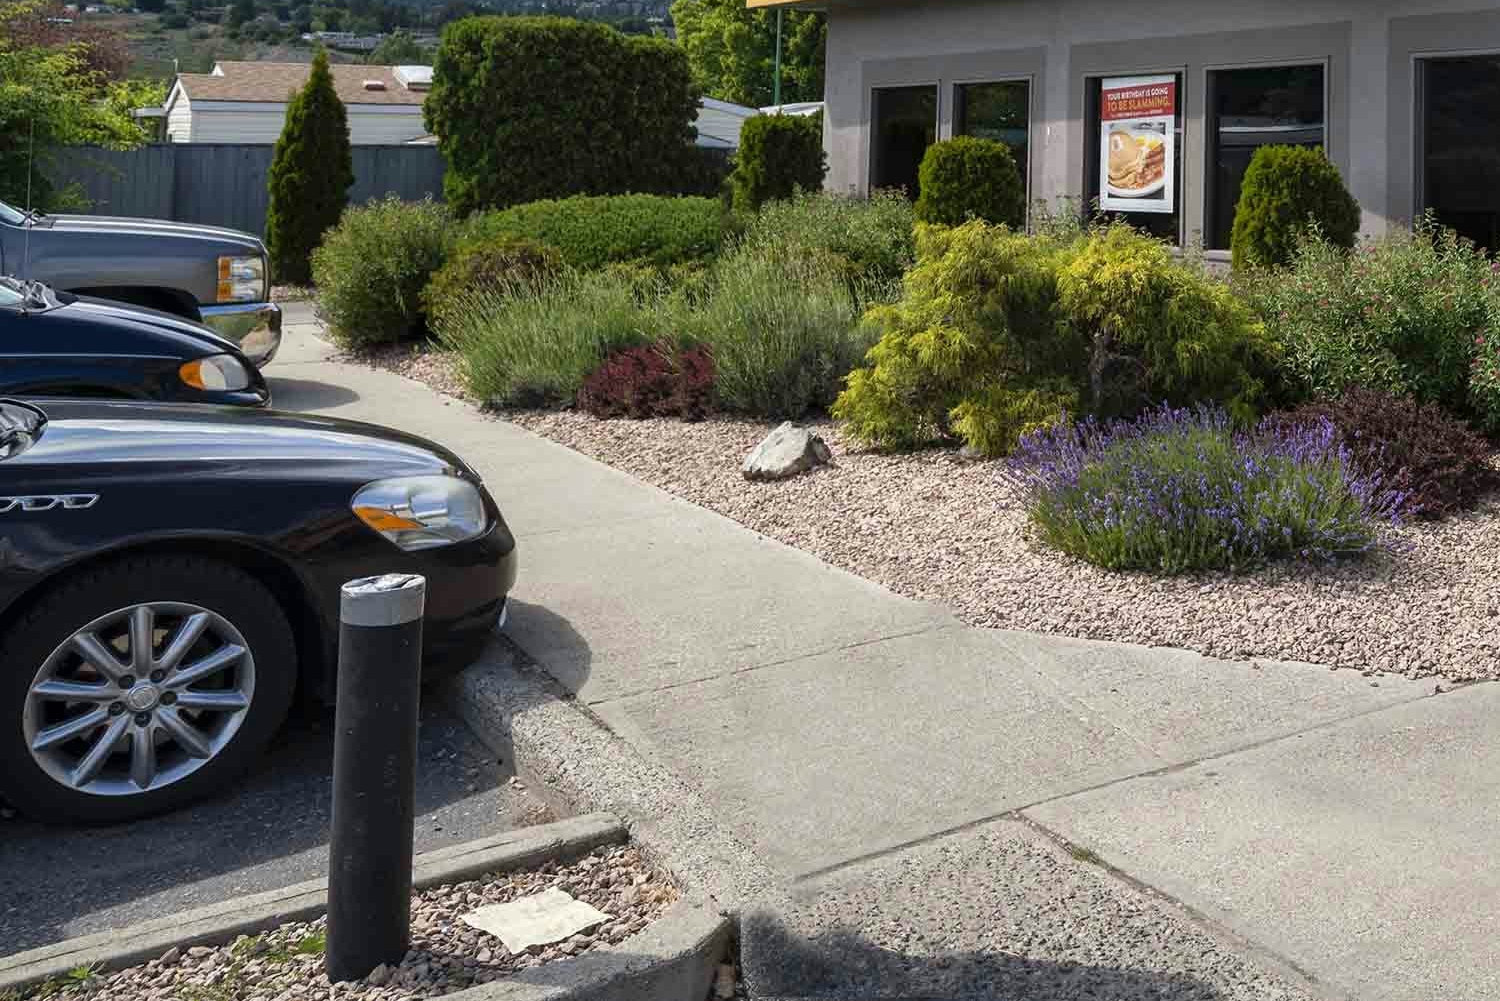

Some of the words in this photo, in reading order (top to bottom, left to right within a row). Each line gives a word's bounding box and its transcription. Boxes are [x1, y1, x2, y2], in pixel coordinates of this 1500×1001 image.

[1107, 93, 1120, 101] YOUR
[1121, 90, 1145, 99] BIRTHDAY
[1151, 87, 1168, 96] GOING
[1107, 101, 1117, 111] TO
[1119, 100, 1128, 111] BE
